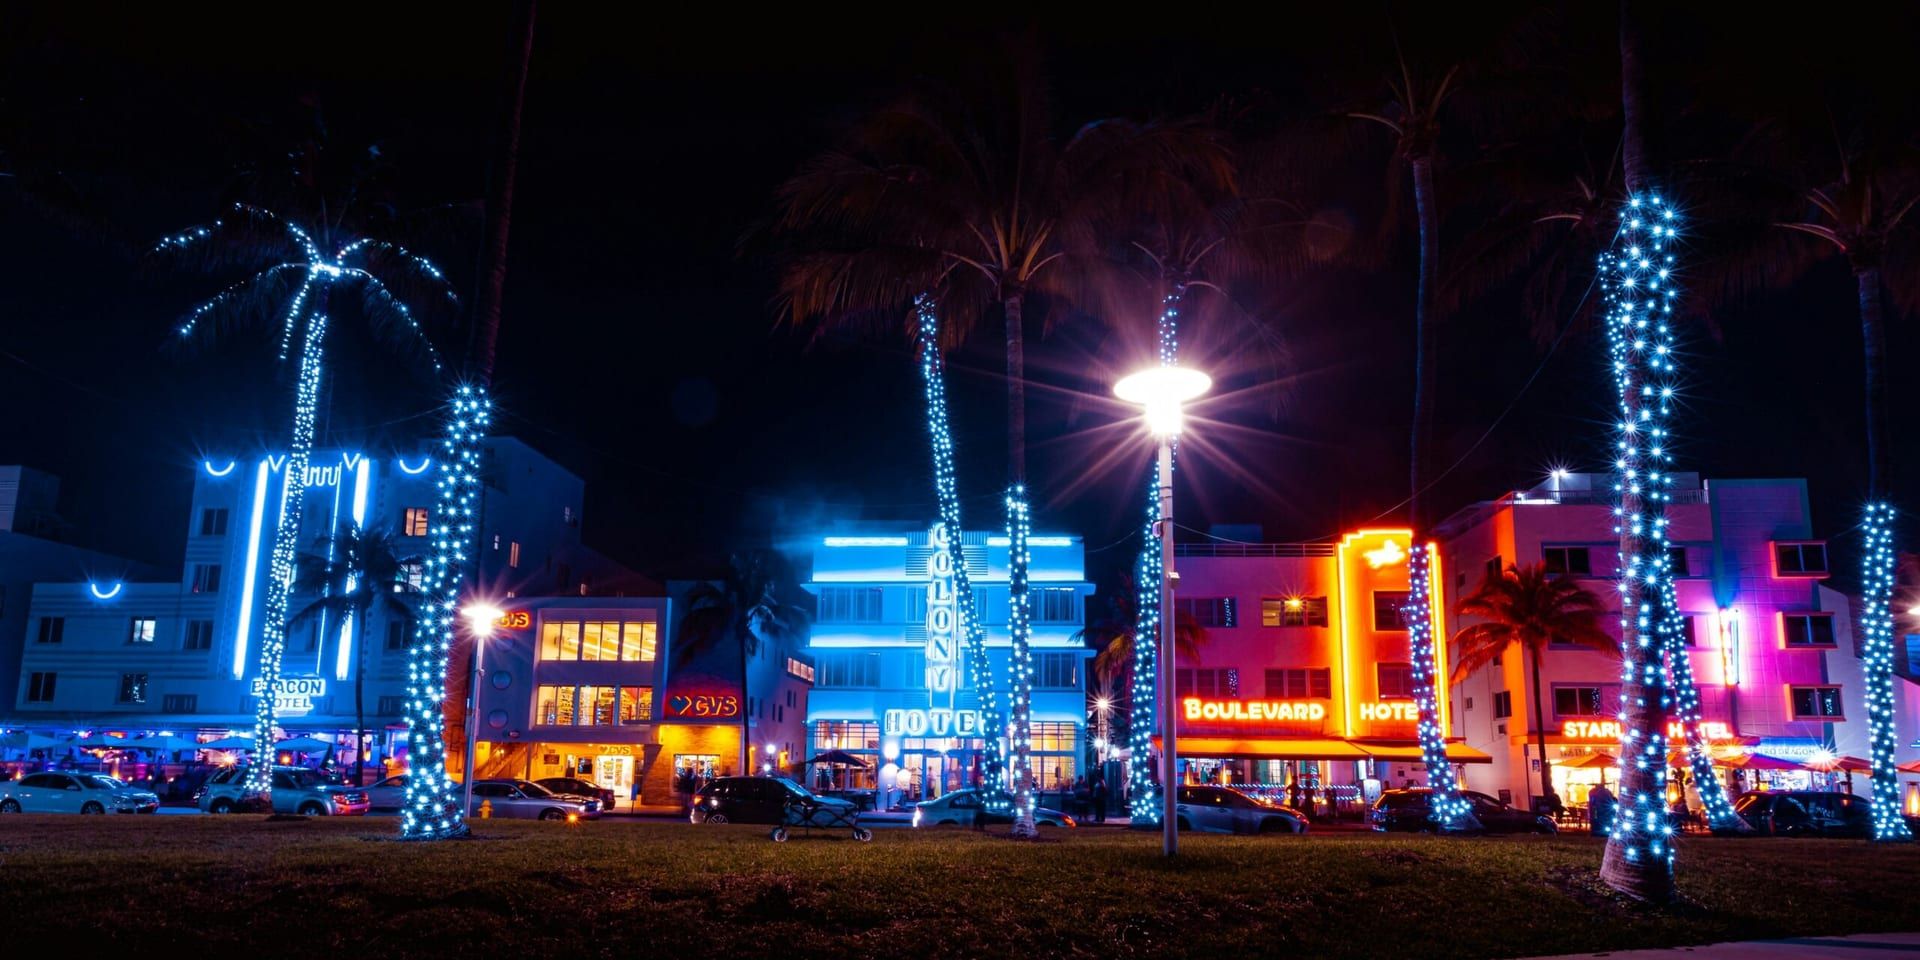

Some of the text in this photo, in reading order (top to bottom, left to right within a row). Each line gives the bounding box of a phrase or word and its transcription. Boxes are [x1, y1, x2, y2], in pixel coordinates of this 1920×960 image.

[933, 523, 952, 689] COLONY
[251, 680, 322, 694] BACON
[274, 697, 312, 708] OTEL
[695, 695, 737, 716] CVS
[1184, 698, 1420, 720] BOULEVARD HOTE
[885, 710, 978, 735] HOTE
[1564, 721, 1734, 739] STARL HTEL
[608, 745, 631, 755] CVS
